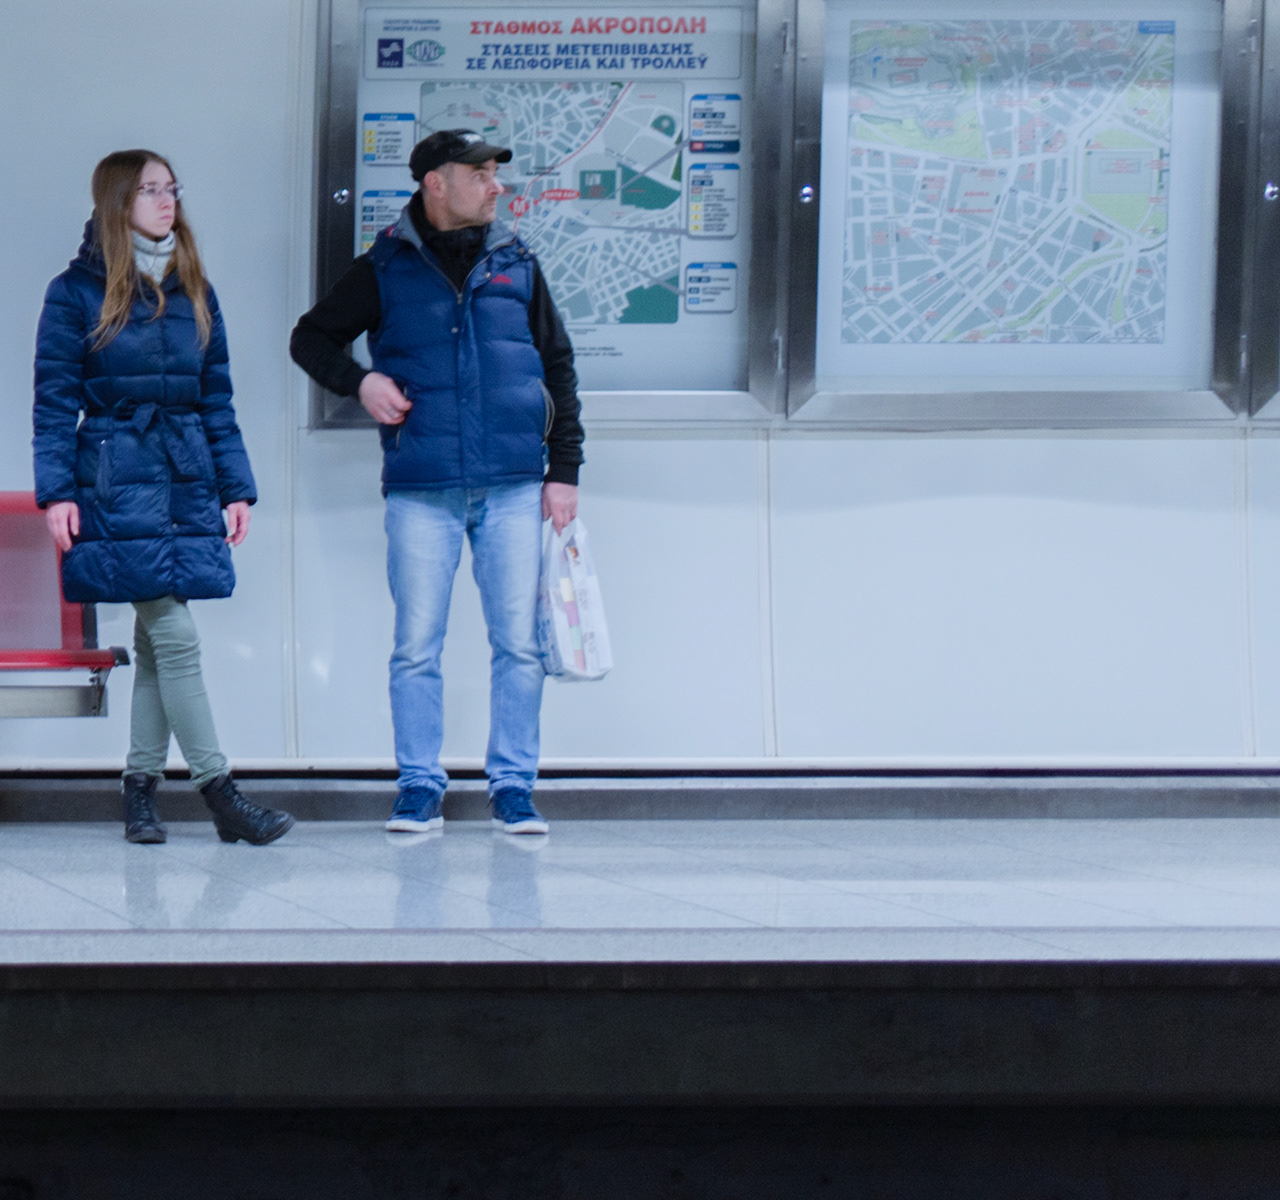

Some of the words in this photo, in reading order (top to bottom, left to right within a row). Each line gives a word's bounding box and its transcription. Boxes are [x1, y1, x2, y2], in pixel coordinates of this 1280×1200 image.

[470, 20, 563, 35] ΣΤΑΘΜΟΣ
[570, 16, 707, 35] ΑΚΡΟΠΟΛΗ
[481, 43, 551, 56] ΣΤΑΣΕΙΣ
[556, 42, 694, 56] ΜΕΤΕΠΙΒΙΒΑΣΗΣ
[466, 57, 486, 70] ΣΕ
[492, 57, 591, 70] ΛΕΩΦΟΡΕΙΑ
[597, 57, 625, 69] ΚΑΙ
